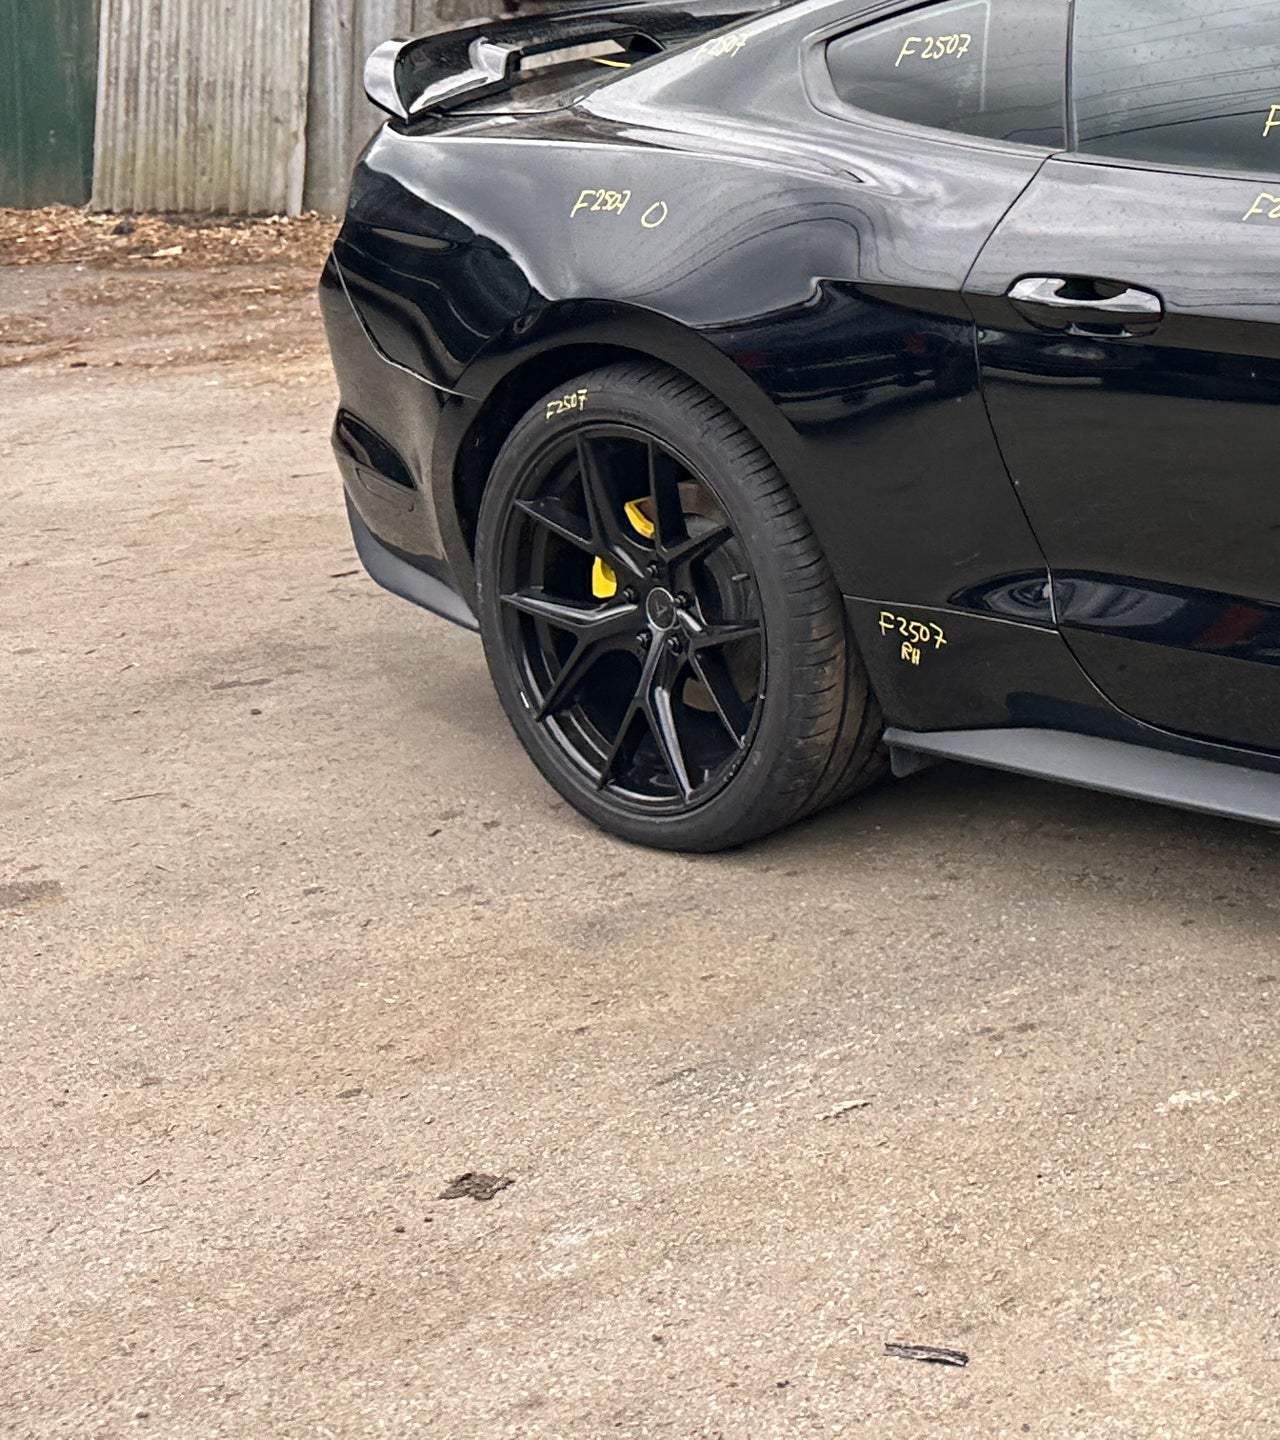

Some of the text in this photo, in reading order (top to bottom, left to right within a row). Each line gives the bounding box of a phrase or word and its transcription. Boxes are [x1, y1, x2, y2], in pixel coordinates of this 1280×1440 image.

[895, 33, 972, 67] F2507
[570, 189, 631, 218] F2507
[545, 388, 589, 422] F2507
[878, 611, 948, 649] F2507
[901, 641, 921, 666] RH
